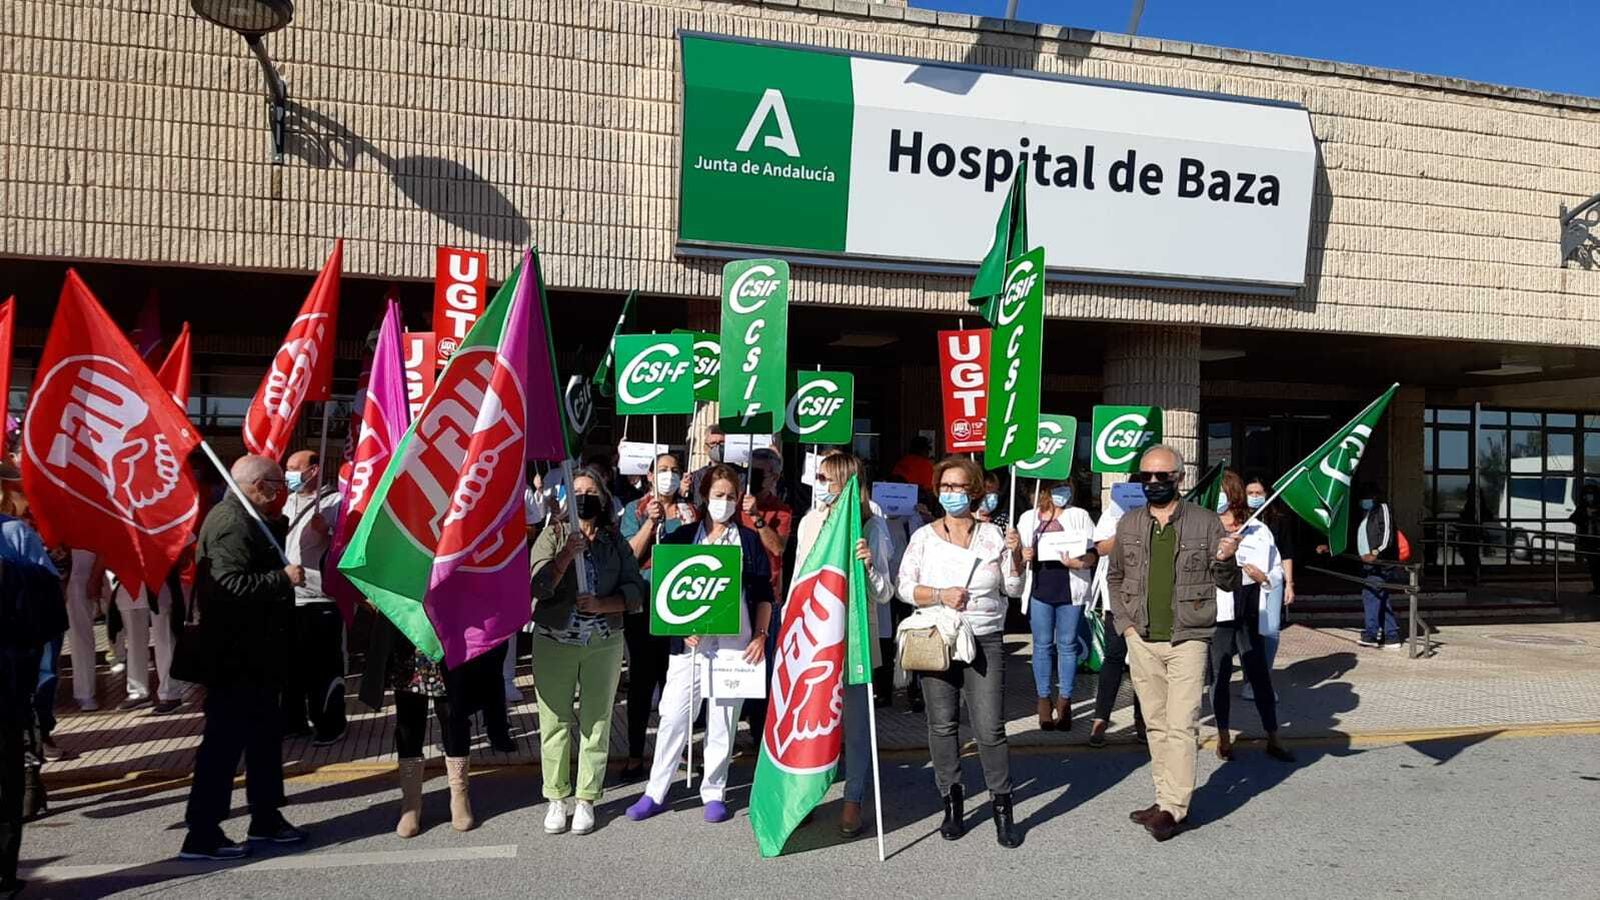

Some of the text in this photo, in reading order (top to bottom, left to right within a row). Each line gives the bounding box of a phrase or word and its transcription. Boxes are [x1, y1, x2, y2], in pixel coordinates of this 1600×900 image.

[694, 155, 836, 182] Junta de Andalucía
[888, 128, 1281, 207] Hospital de Baza
[445, 253, 479, 339] UGT
[739, 279, 781, 297] CSIF
[1004, 273, 1038, 306] CSIF
[740, 318, 766, 428] CSIF
[948, 335, 986, 417] UGT
[797, 395, 845, 416] CSIF
[1000, 324, 1024, 458] CSIF
[1036, 436, 1067, 455] SIF
[1107, 429, 1155, 448] CSIF
[671, 575, 731, 601] CSIF
